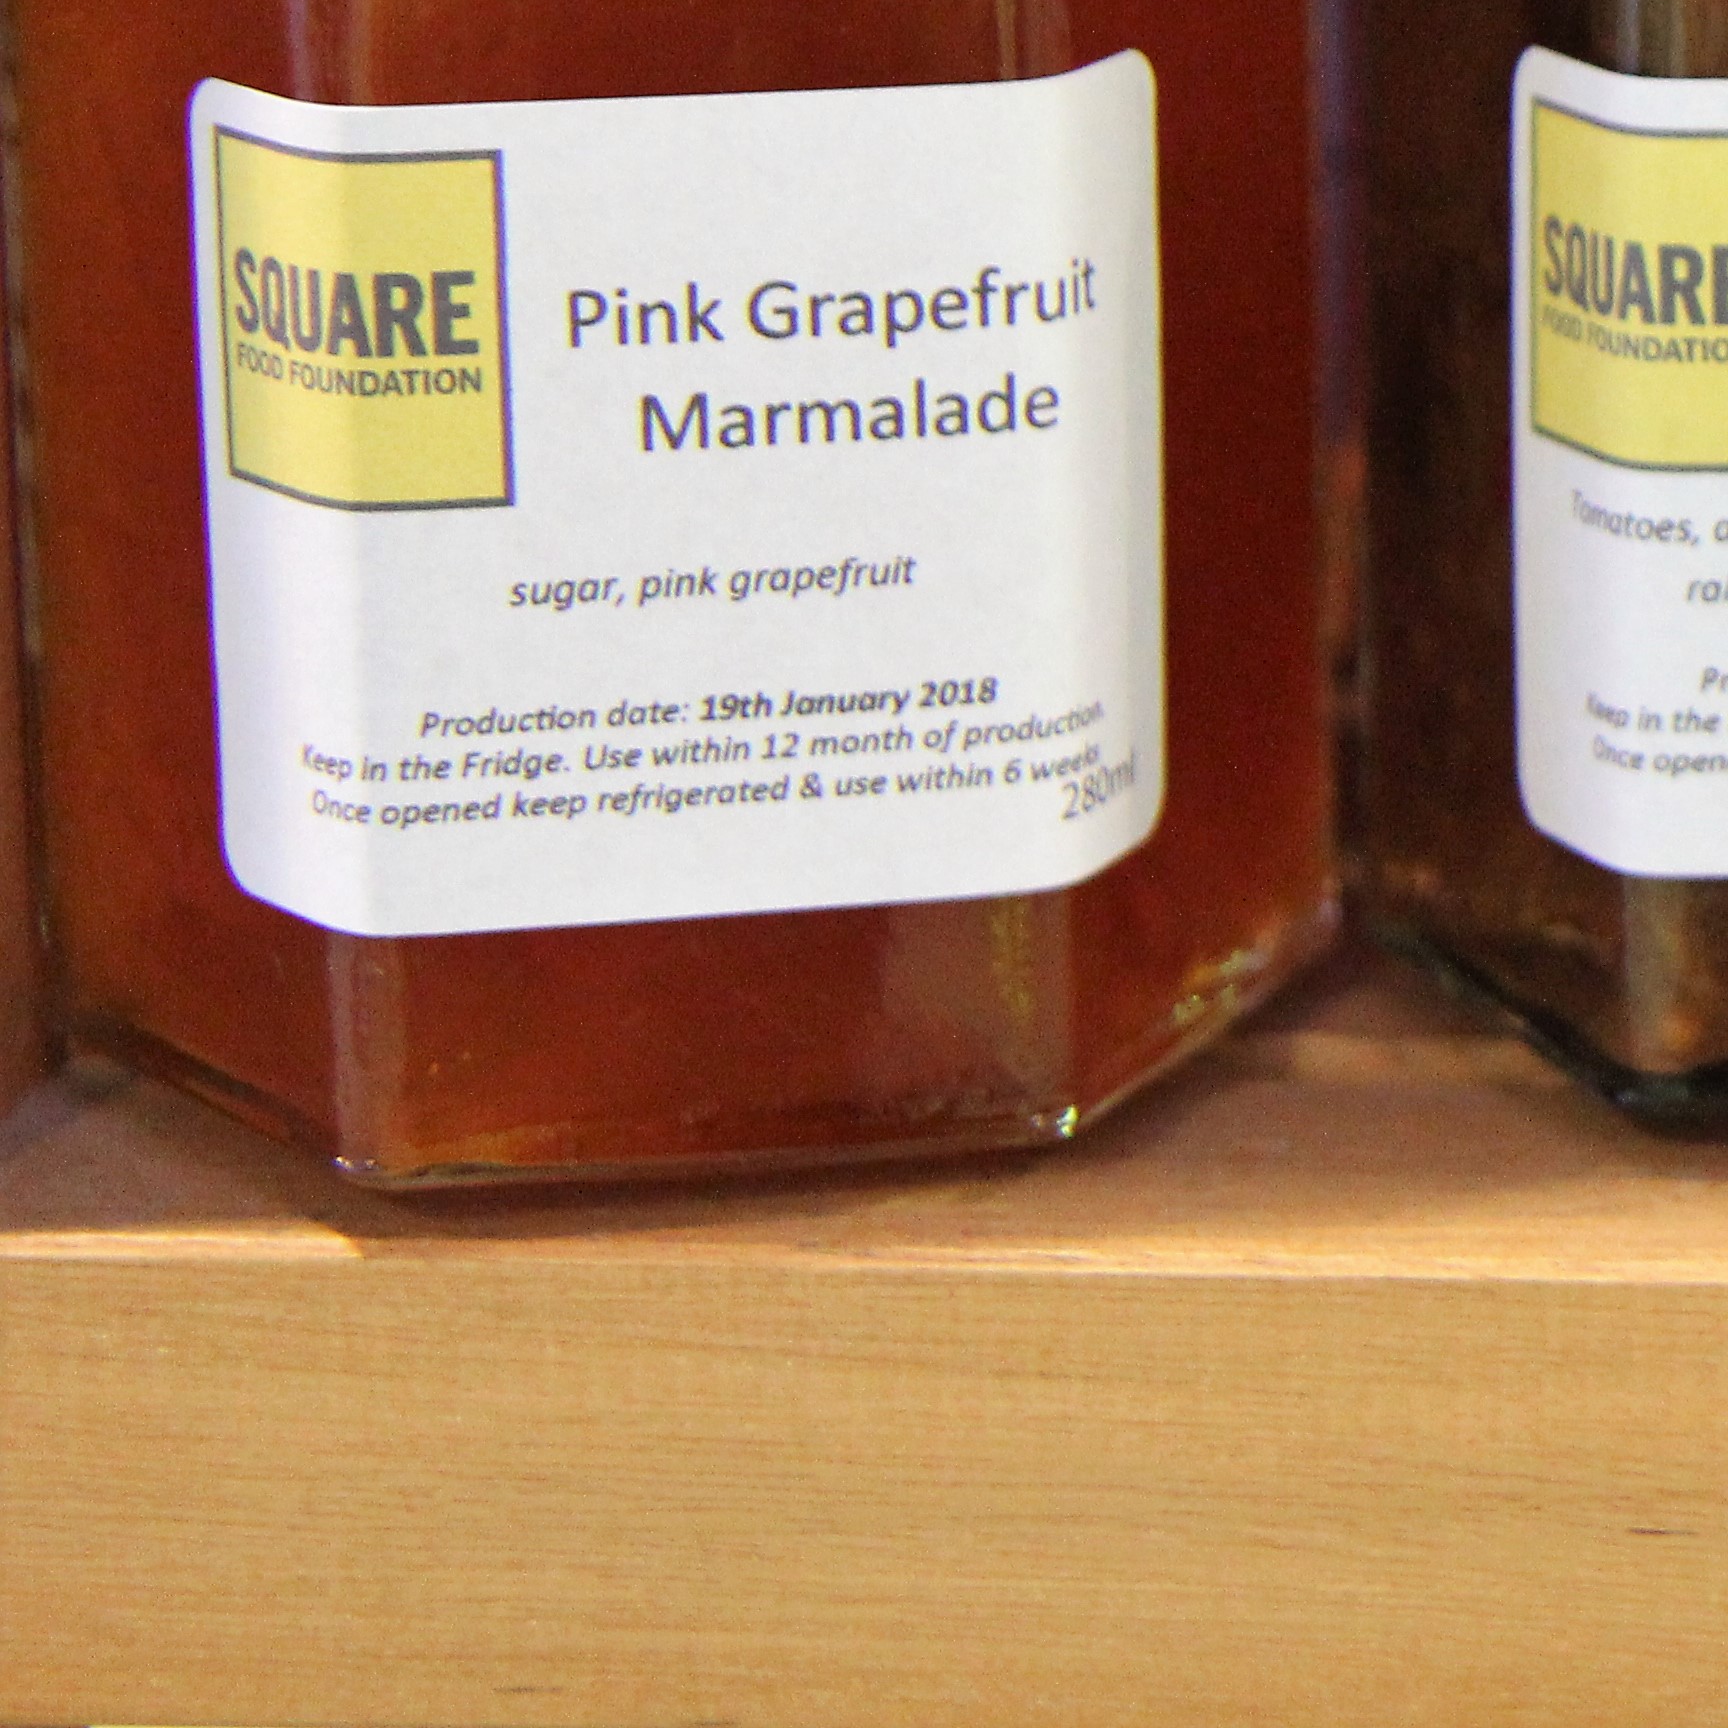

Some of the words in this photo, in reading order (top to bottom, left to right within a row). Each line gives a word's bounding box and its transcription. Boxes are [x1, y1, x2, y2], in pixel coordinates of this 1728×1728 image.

[235, 248, 479, 357] SQUARE
[567, 281, 725, 347] Pink
[748, 257, 1096, 348] Grapefruit
[236, 341, 283, 379] FOOD
[290, 360, 481, 396] FOUNDATION
[639, 372, 1059, 452] Marmalade
[509, 575, 625, 610] sugar,
[638, 568, 716, 606] pink
[730, 556, 916, 600] grapefruit
[419, 706, 596, 736] Production
[606, 699, 691, 726] date:
[699, 691, 772, 720] 19th
[780, 685, 908, 717] January
[918, 676, 998, 707] 2018
[1638, 706, 1661, 731] in
[1672, 708, 1720, 733] the
[301, 743, 353, 782] Keep
[361, 755, 387, 782] in
[398, 754, 451, 780] the
[462, 749, 570, 779] Fridge.
[585, 745, 643, 771] Use
[653, 734, 749, 766] within
[761, 733, 799, 759] 12
[809, 724, 913, 756] month
[923, 720, 958, 753] of
[312, 788, 371, 824] Once
[380, 793, 500, 829] opened
[512, 791, 587, 820] keep
[596, 774, 789, 815] refrigerated
[799, 772, 823, 800] &
[836, 774, 888, 796] use
[899, 761, 993, 792] within
[1004, 759, 1022, 783] 6
